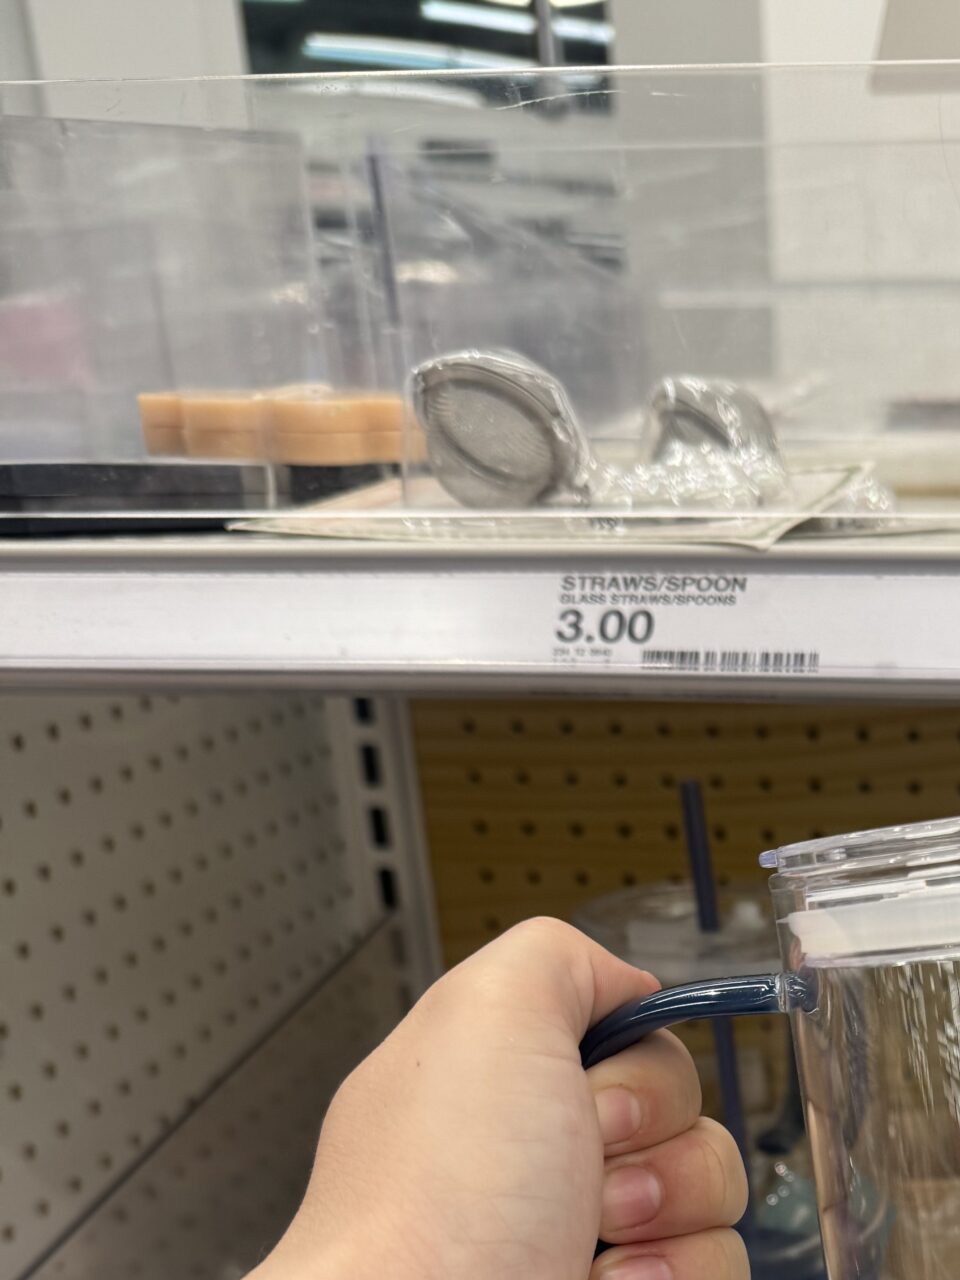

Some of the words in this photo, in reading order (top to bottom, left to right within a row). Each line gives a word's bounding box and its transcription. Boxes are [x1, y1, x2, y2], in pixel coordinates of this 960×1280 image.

[561, 575, 748, 593] STRAWS/SPOON
[559, 594, 607, 605] GLASS
[610, 594, 737, 606] STRAWS/SPOONS
[555, 609, 655, 643] 3.00
